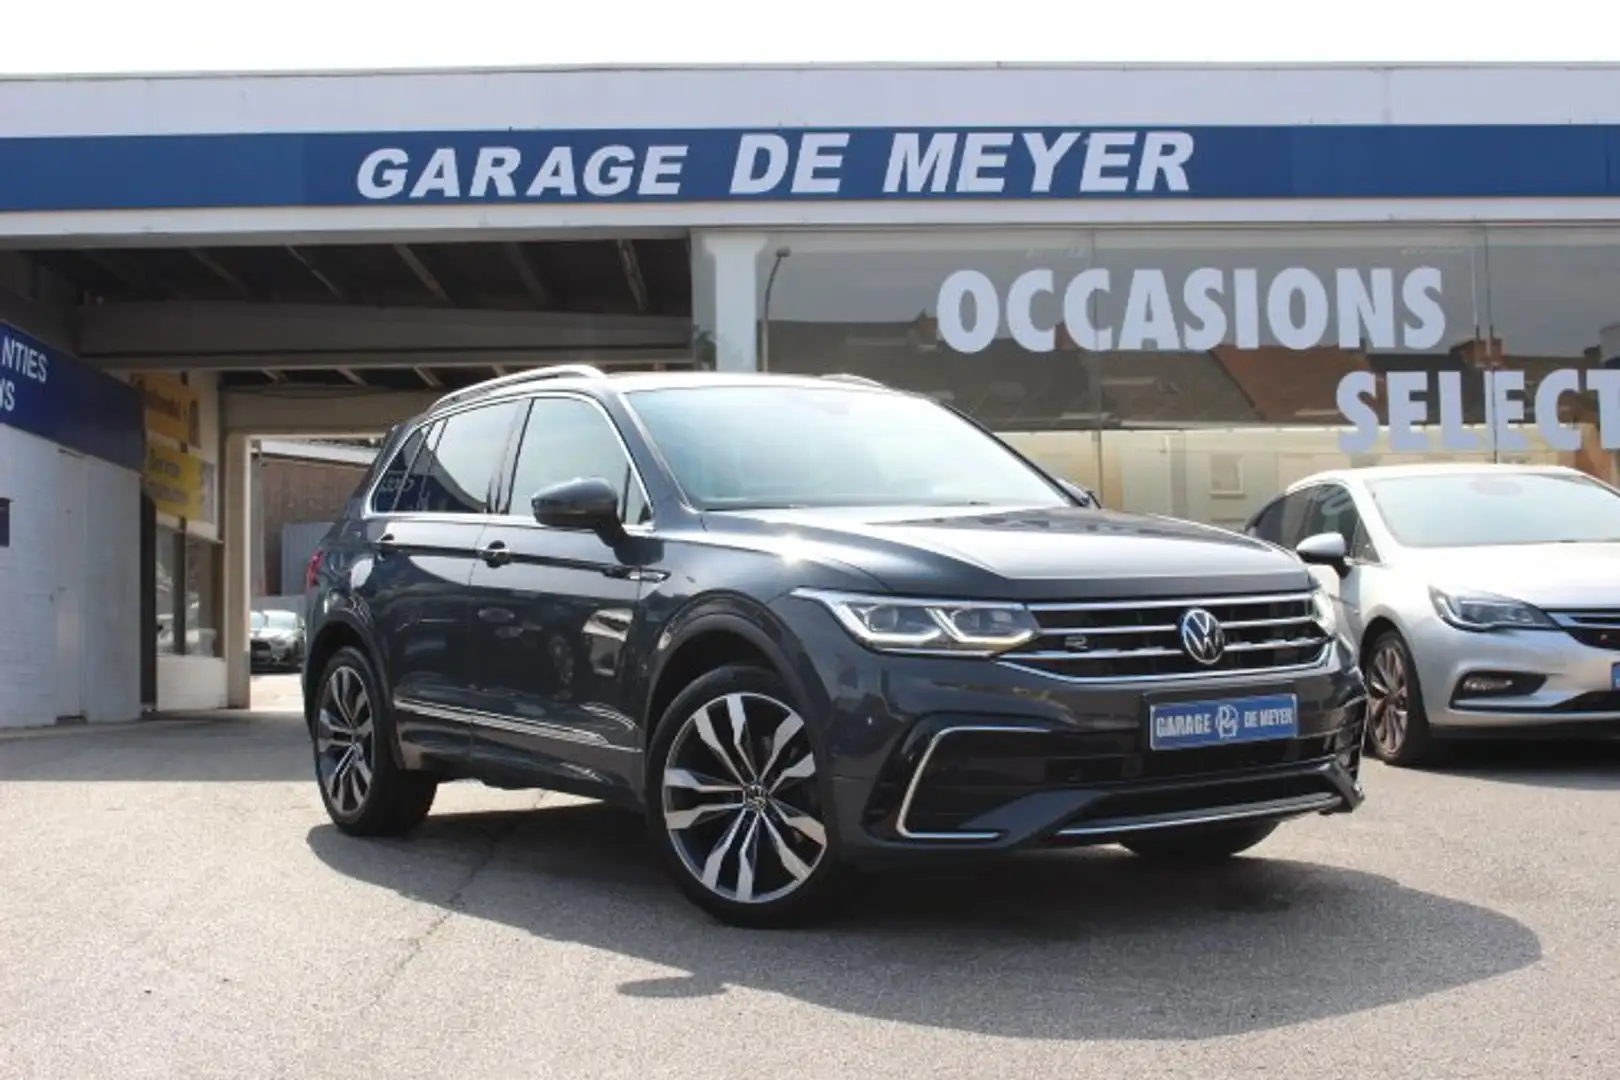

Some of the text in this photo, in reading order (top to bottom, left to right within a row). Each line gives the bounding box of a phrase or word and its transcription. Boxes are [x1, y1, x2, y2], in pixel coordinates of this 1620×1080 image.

[356, 131, 1194, 199] GARAGE DE MEYER
[936, 266, 1446, 352] OCCASIONS
[2, 337, 48, 384] NTIES
[1335, 368, 1620, 453] SELECT
[1156, 713, 1212, 738] GARAGE
[1244, 711, 1258, 728] DE
[1260, 707, 1293, 726] MEYER
